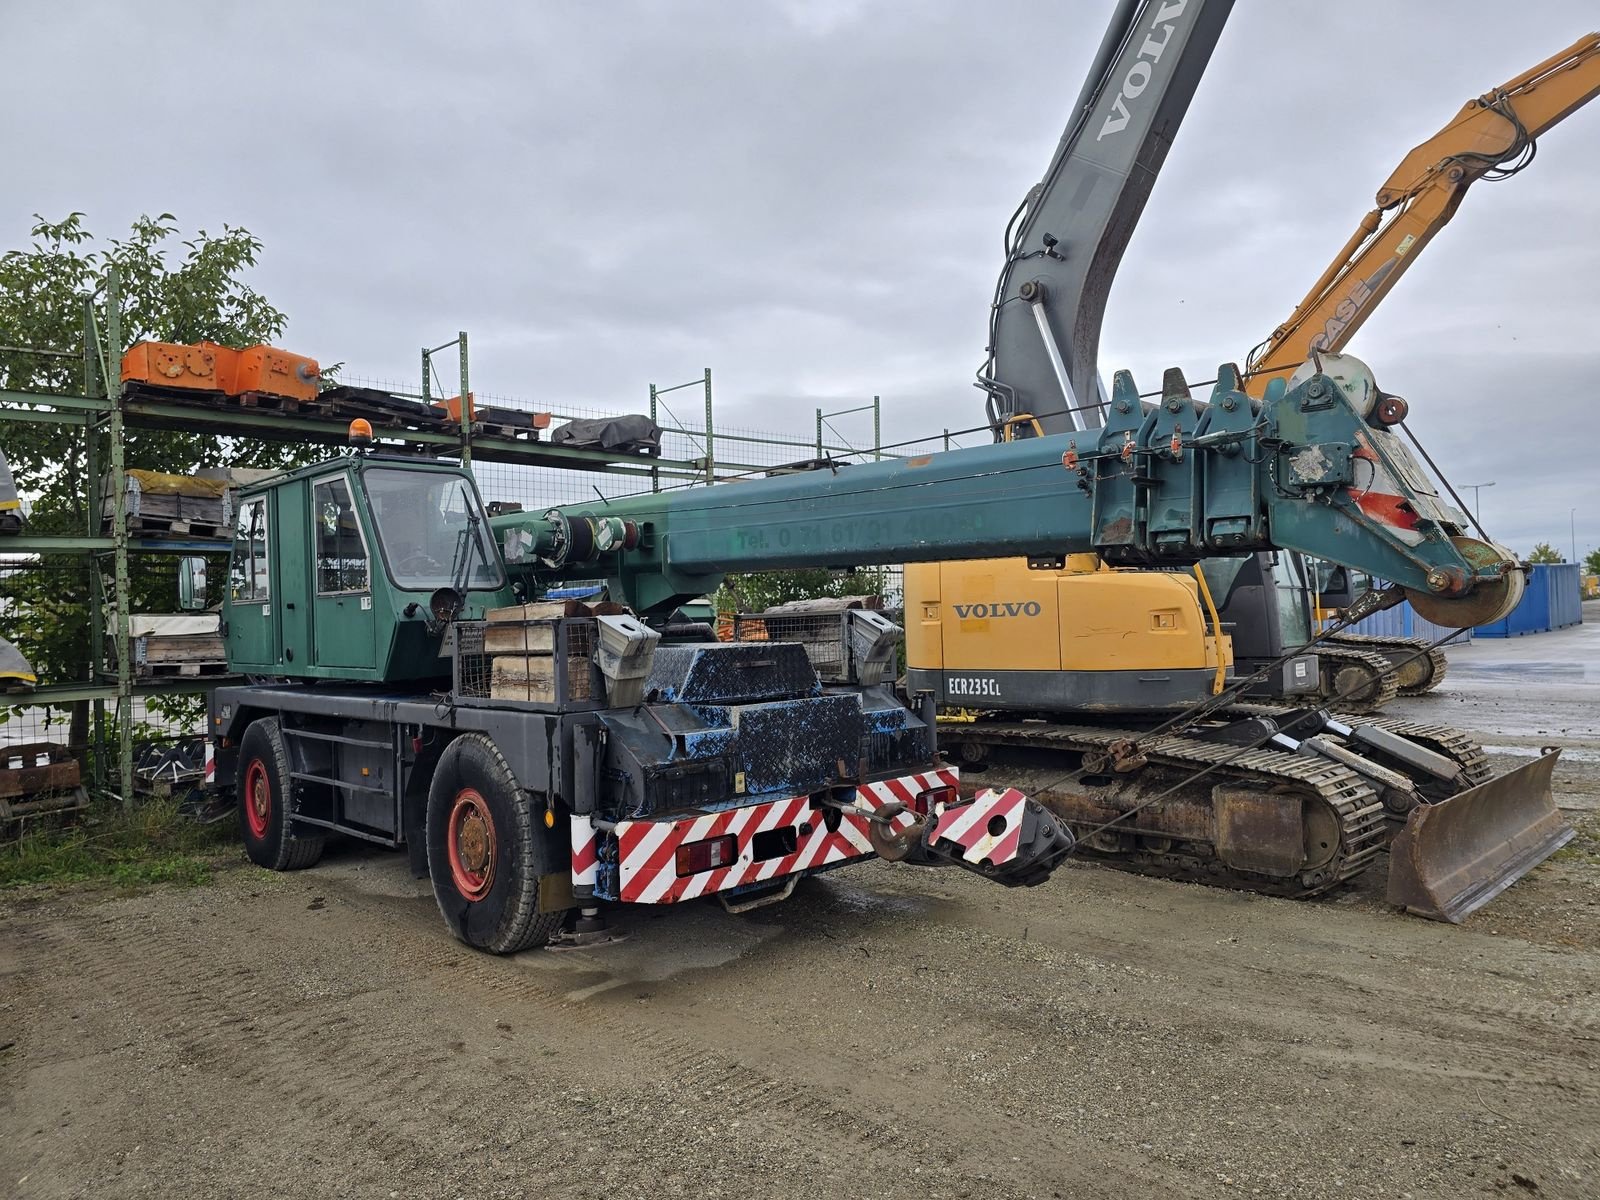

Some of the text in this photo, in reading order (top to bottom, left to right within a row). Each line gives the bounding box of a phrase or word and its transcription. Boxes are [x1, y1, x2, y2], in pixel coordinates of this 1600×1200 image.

[1308, 278, 1372, 355] CASE
[737, 530, 769, 550] Tel.
[779, 527, 791, 547] 0
[953, 601, 1041, 618] VOLVO
